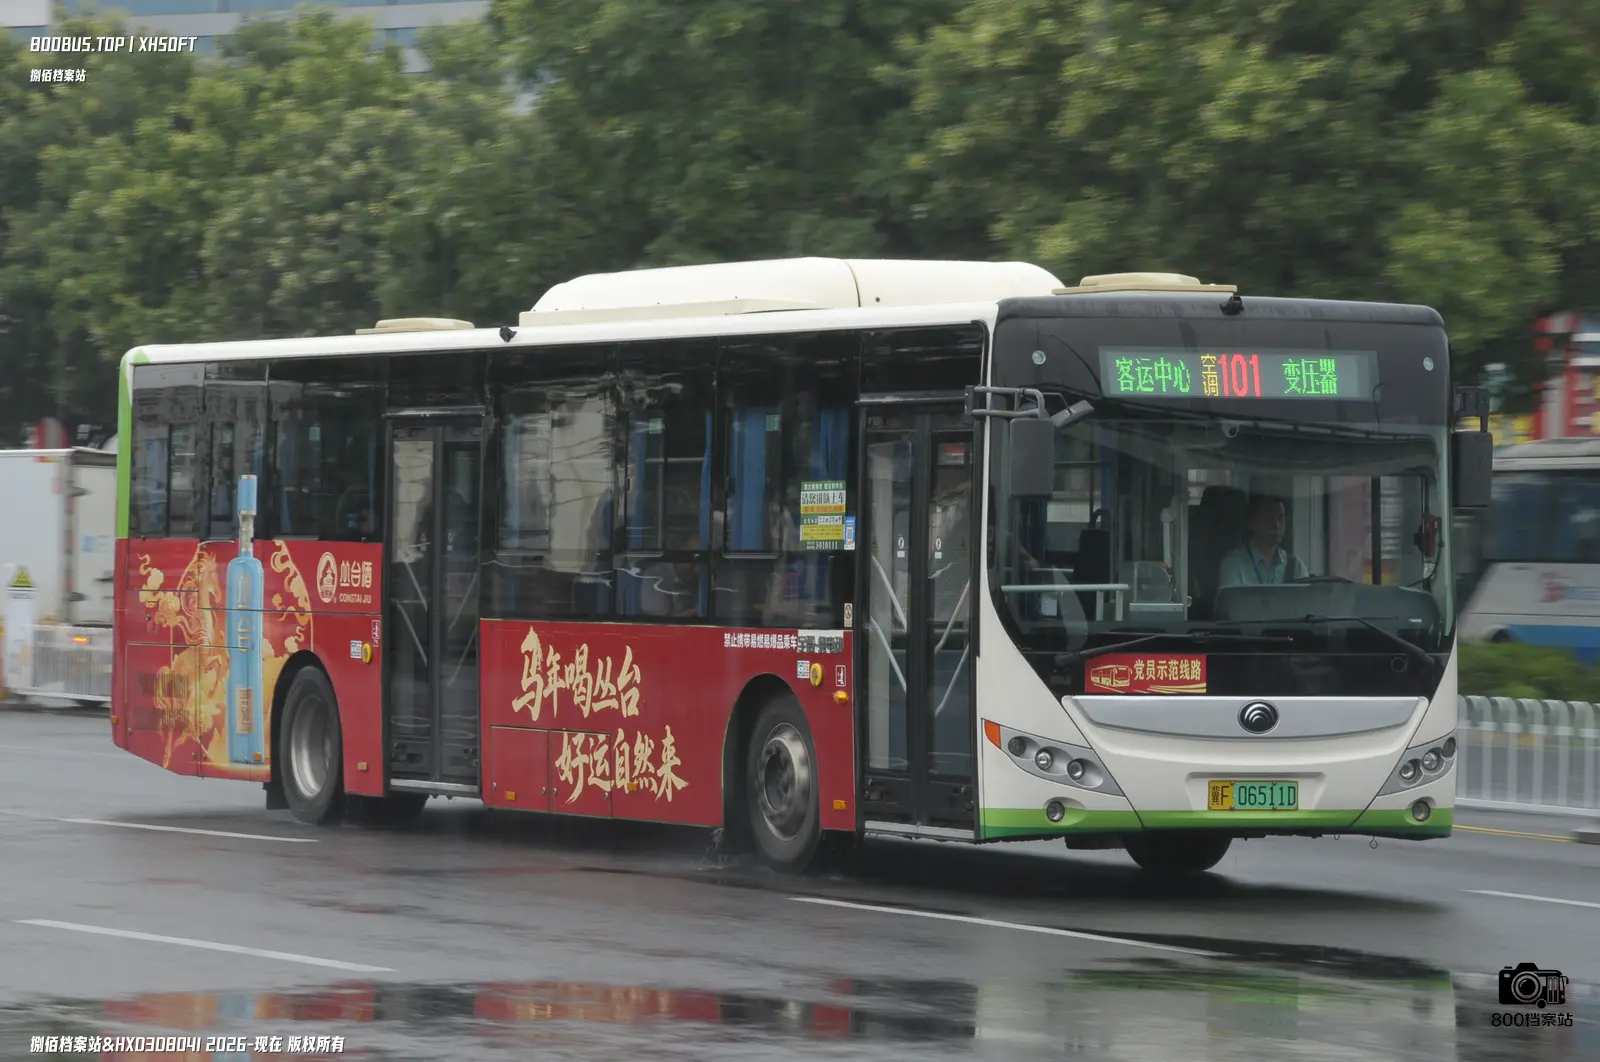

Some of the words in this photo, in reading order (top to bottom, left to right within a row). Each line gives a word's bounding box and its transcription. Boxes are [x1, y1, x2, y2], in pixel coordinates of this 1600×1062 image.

[1115, 356, 1191, 393] 客运中心
[1200, 354, 1219, 396] 空调
[1218, 354, 1261, 397] 101
[1282, 358, 1338, 394] 变压器
[340, 560, 373, 588] 丛台酒
[724, 633, 797, 649] 禁止携带易燃易爆品乘车
[511, 626, 641, 721] 马年喝丛台
[1133, 659, 1201, 681] 党员示范线路
[555, 725, 689, 803] 好运自然来
